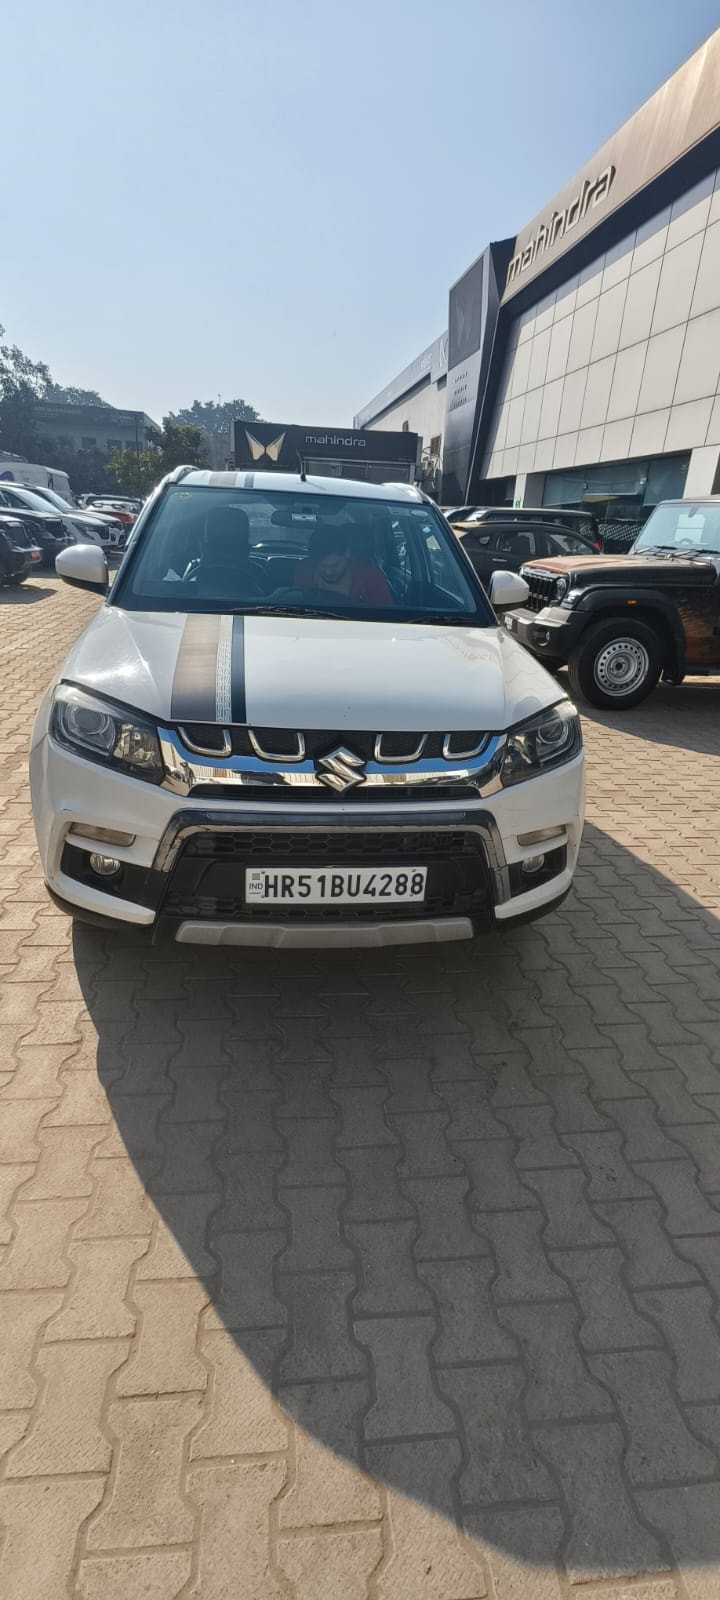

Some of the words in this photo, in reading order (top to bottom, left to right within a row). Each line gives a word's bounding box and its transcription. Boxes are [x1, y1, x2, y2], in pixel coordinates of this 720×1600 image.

[508, 165, 614, 281] mahindra
[305, 434, 366, 447] mahindra
[248, 882, 263, 890] IND
[264, 873, 424, 898] HR51BU4288
